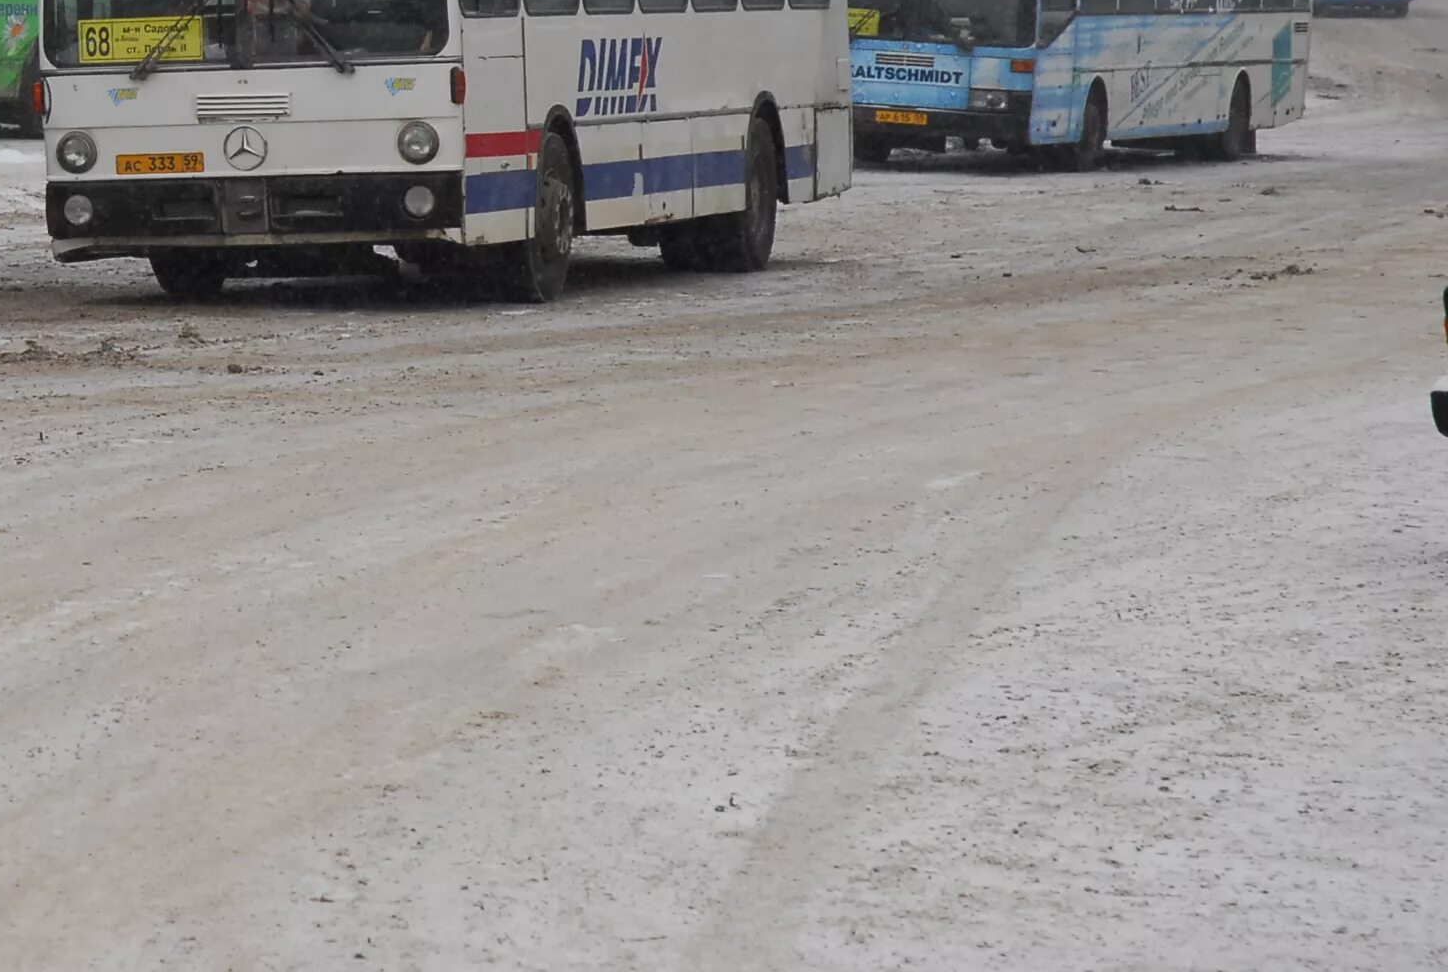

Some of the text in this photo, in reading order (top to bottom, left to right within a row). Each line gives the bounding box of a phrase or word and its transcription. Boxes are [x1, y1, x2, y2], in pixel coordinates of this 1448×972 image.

[122, 25, 141, 33] м-н
[85, 26, 110, 57] 68
[575, 32, 662, 117] DIMEX
[148, 155, 176, 171] 333
[183, 154, 198, 166] 59
